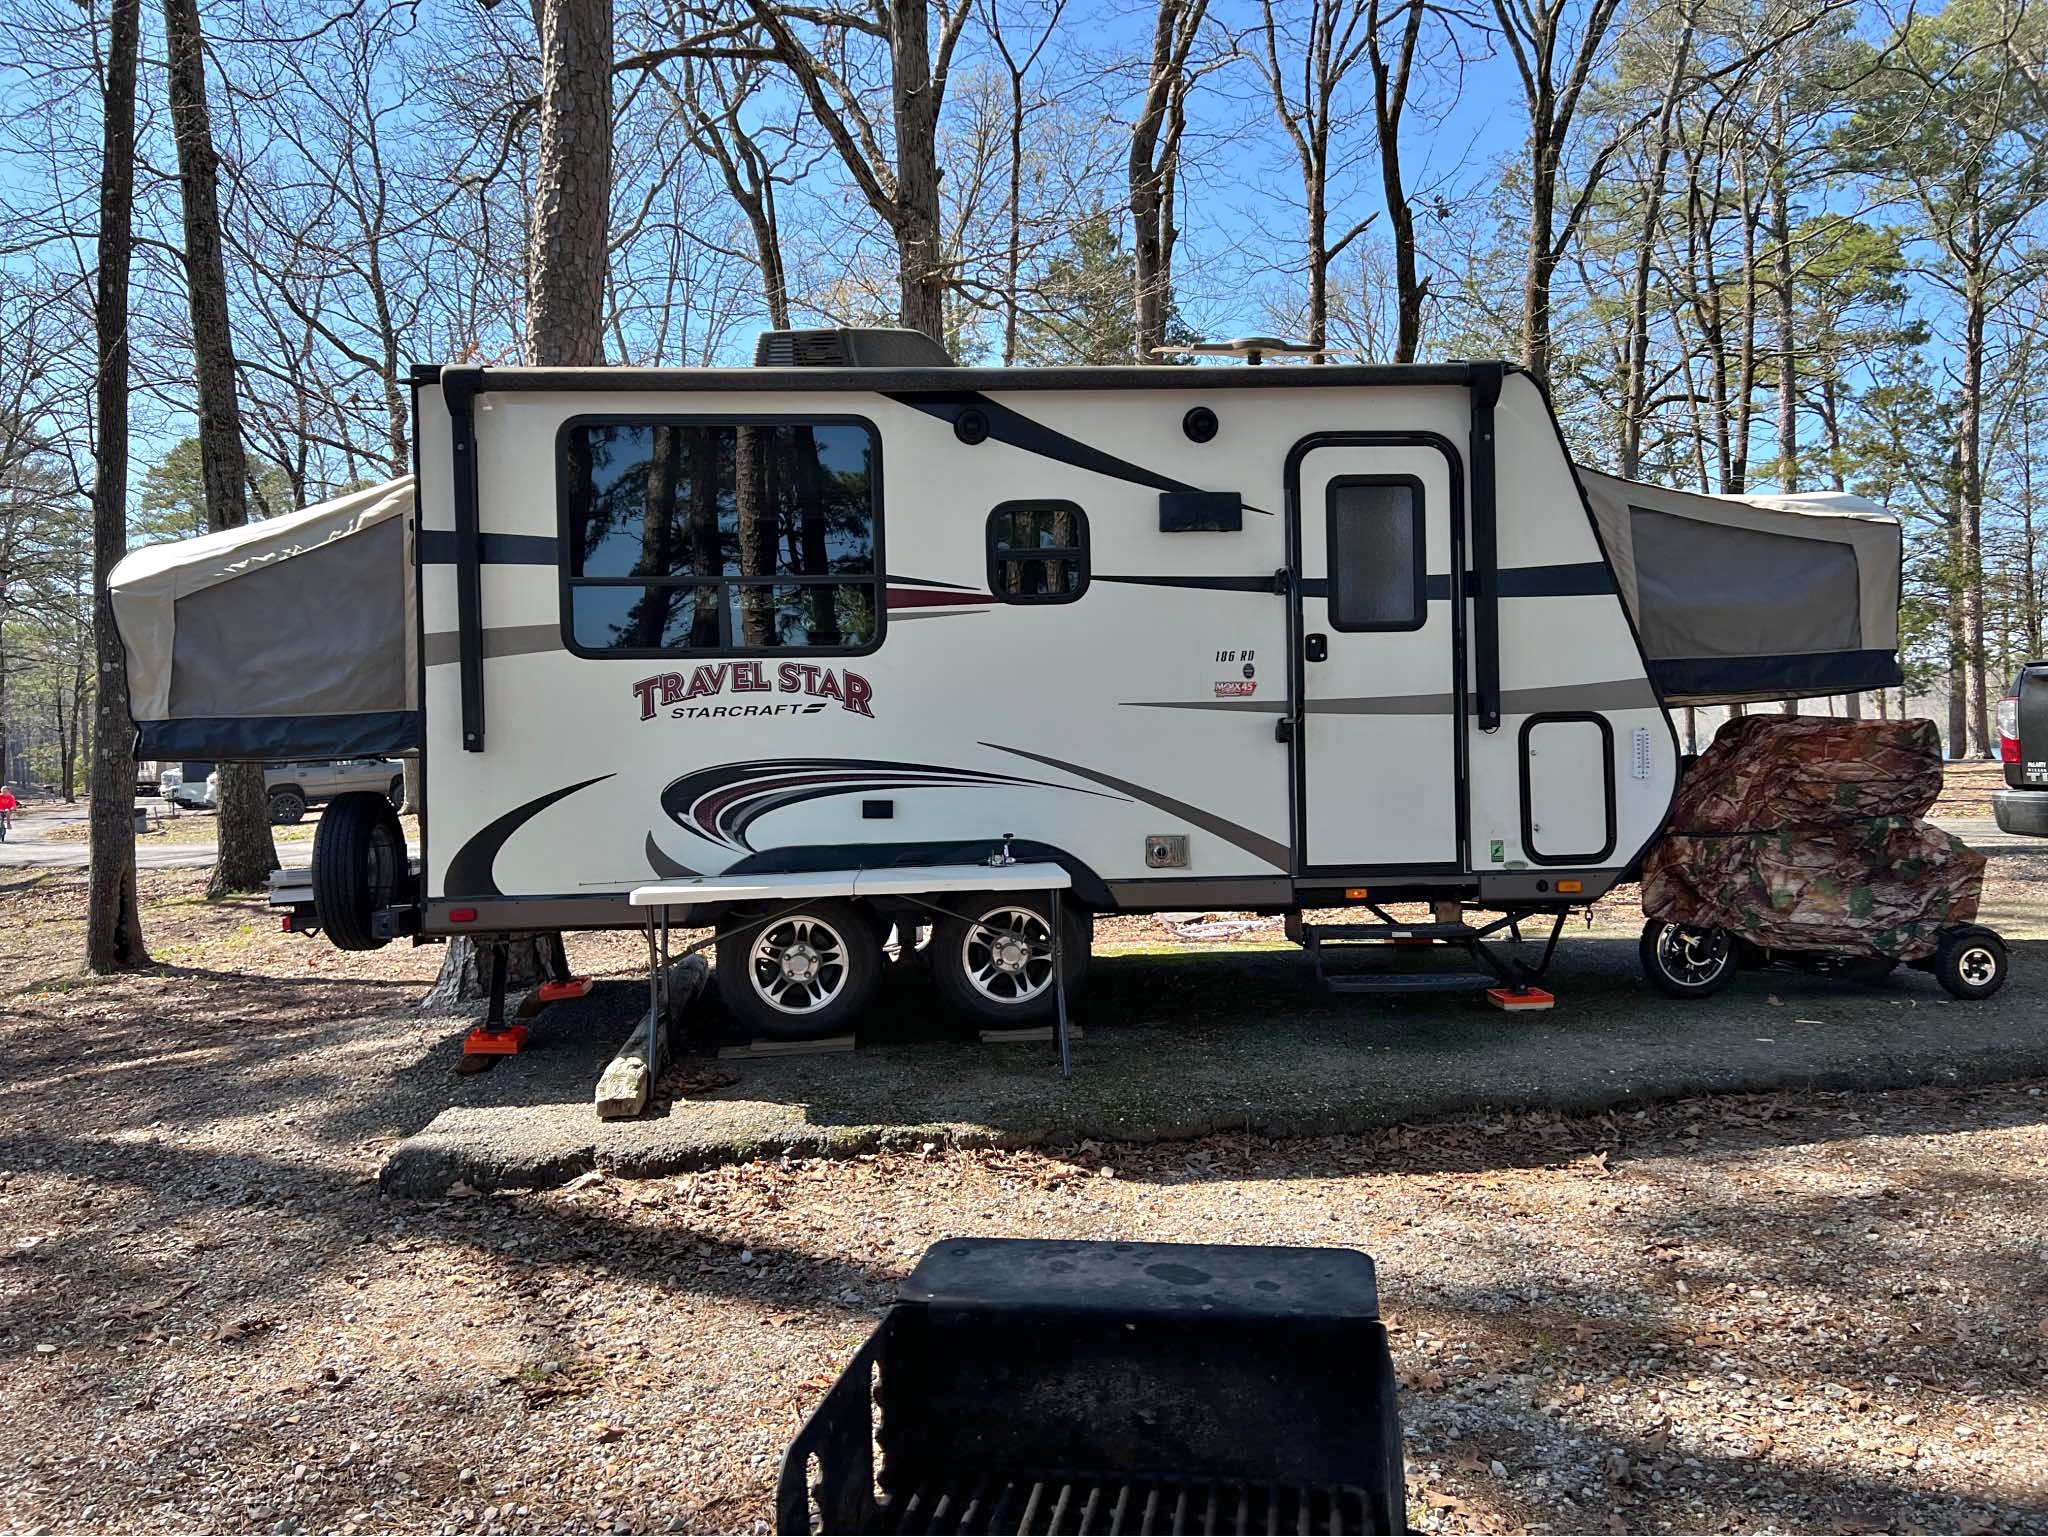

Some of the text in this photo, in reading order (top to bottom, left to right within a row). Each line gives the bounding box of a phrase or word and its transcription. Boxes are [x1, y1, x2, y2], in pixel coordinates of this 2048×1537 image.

[1215, 650, 1255, 662] 186 RD
[633, 661, 875, 721] TRAVEL STAR
[671, 704, 802, 719] STARCRAFT
